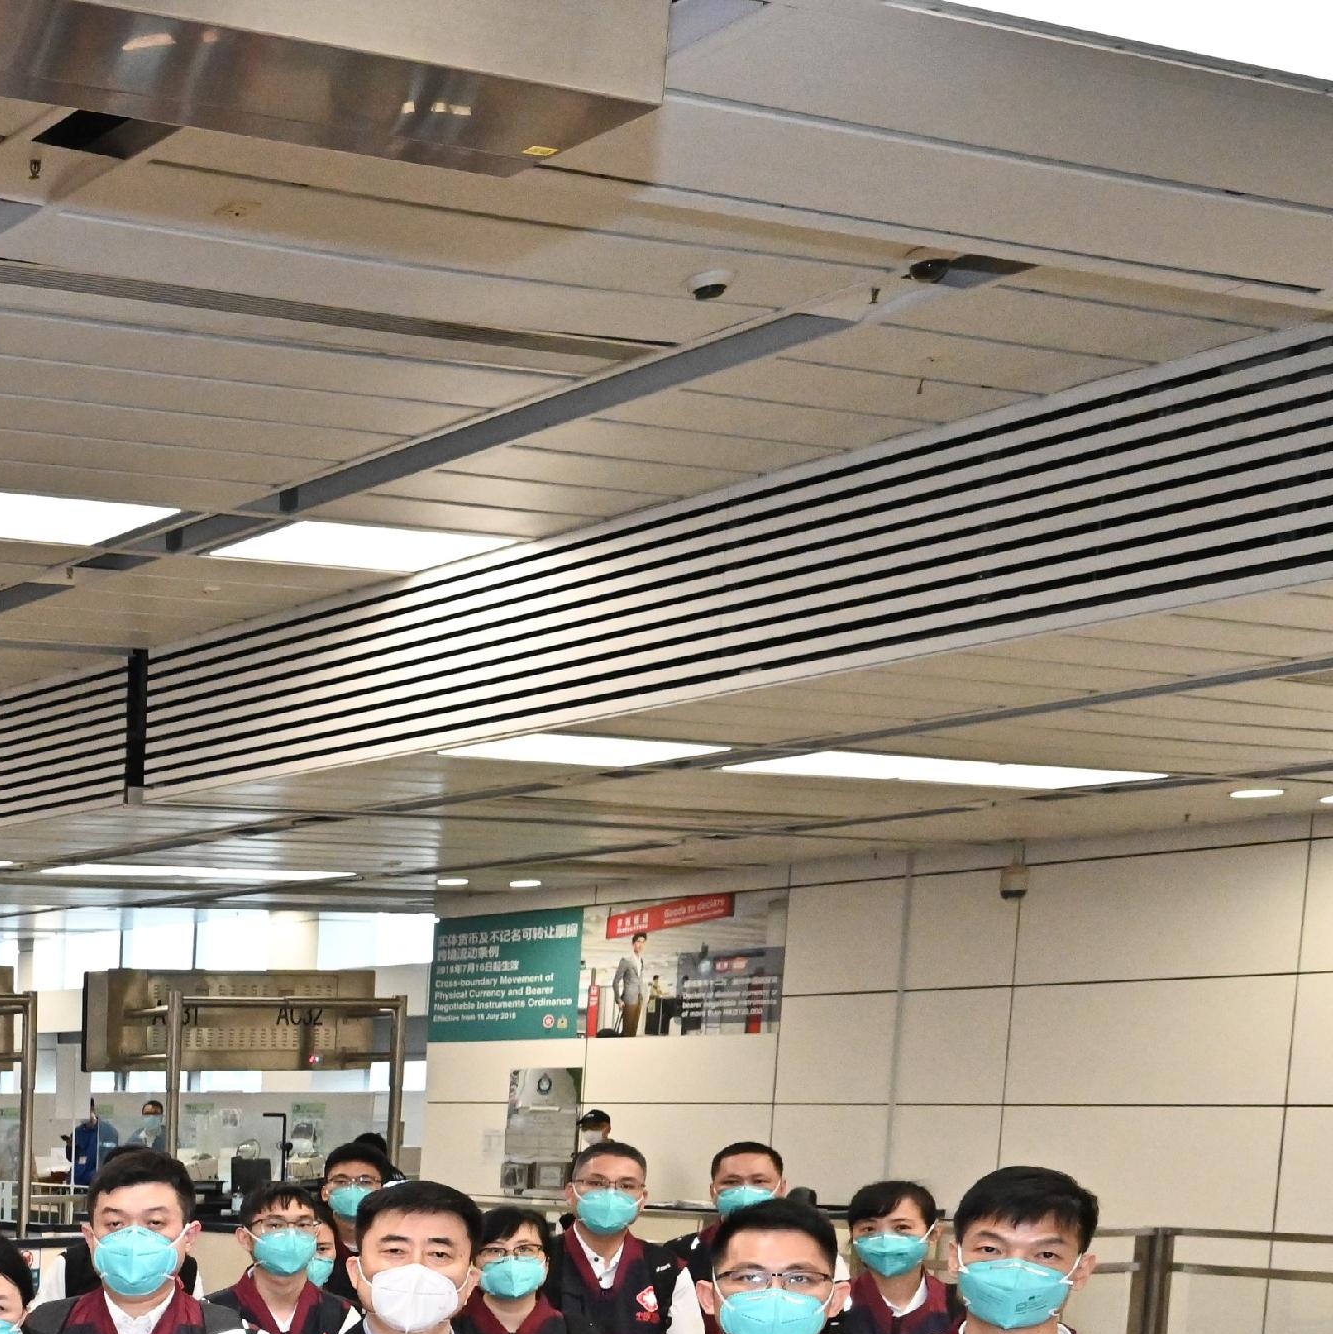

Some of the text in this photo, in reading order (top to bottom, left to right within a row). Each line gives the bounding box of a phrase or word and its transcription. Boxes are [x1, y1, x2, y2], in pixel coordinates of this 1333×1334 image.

[435, 973, 554, 988] Cross-boundary Movement of
[434, 986, 554, 1000] Physical Currency and Bearer
[434, 998, 573, 1013] Negotiable Instruments Ordinance
[275, 1007, 323, 1026] AC32
[486, 1013, 500, 1021] July
